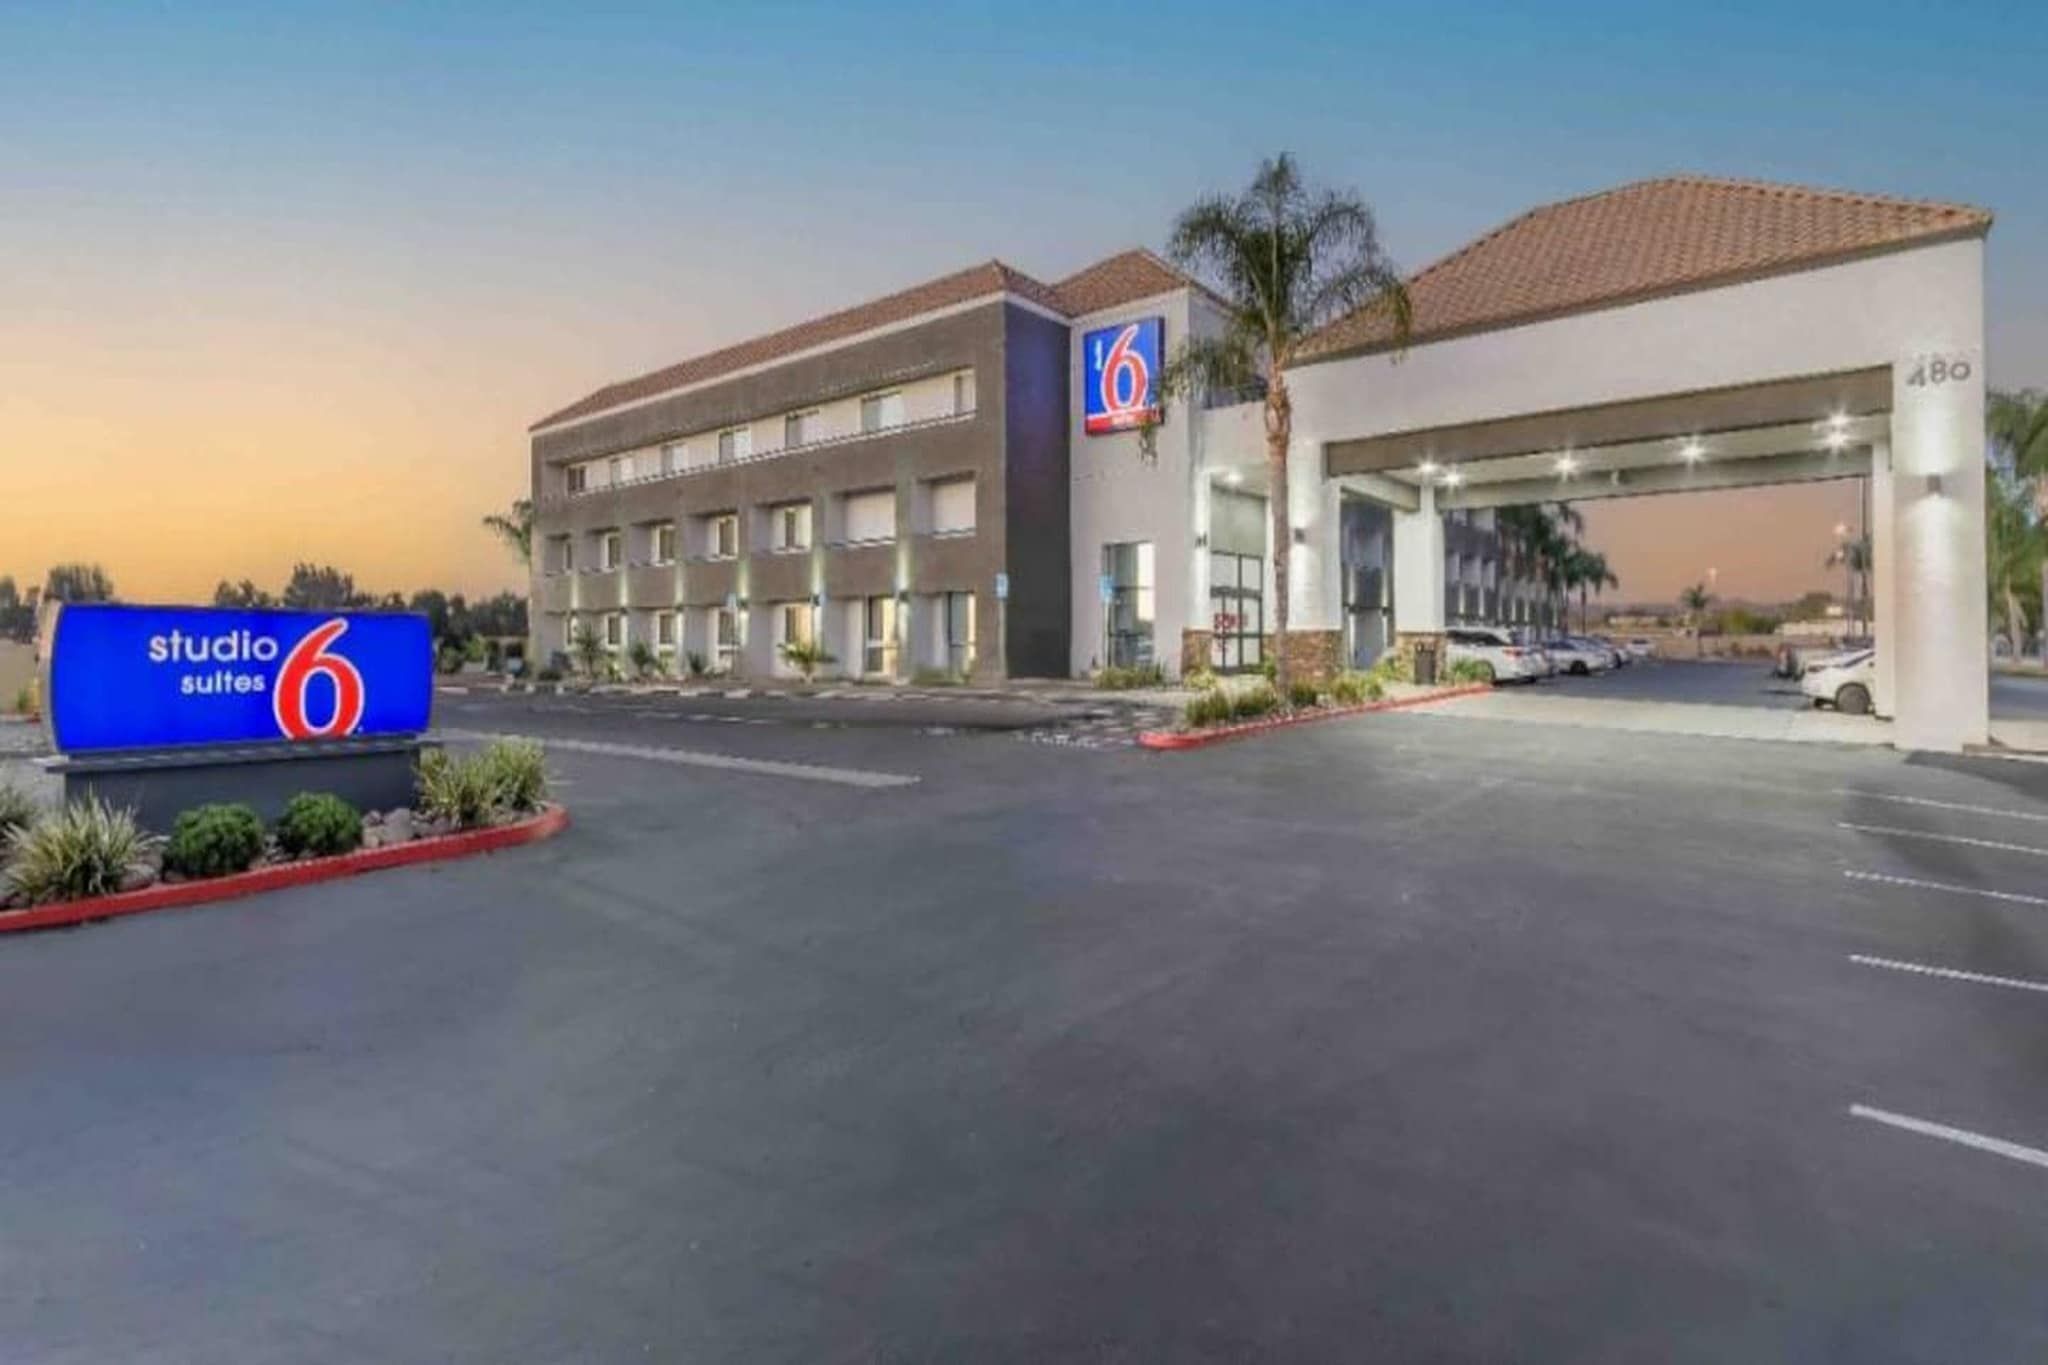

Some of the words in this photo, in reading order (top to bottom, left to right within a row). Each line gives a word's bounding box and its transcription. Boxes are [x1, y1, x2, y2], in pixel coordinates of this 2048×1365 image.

[1101, 323, 1148, 415] 6
[1906, 359, 1971, 387] 480
[149, 629, 279, 662] studio
[272, 617, 365, 740] 6
[181, 669, 266, 694] suites
